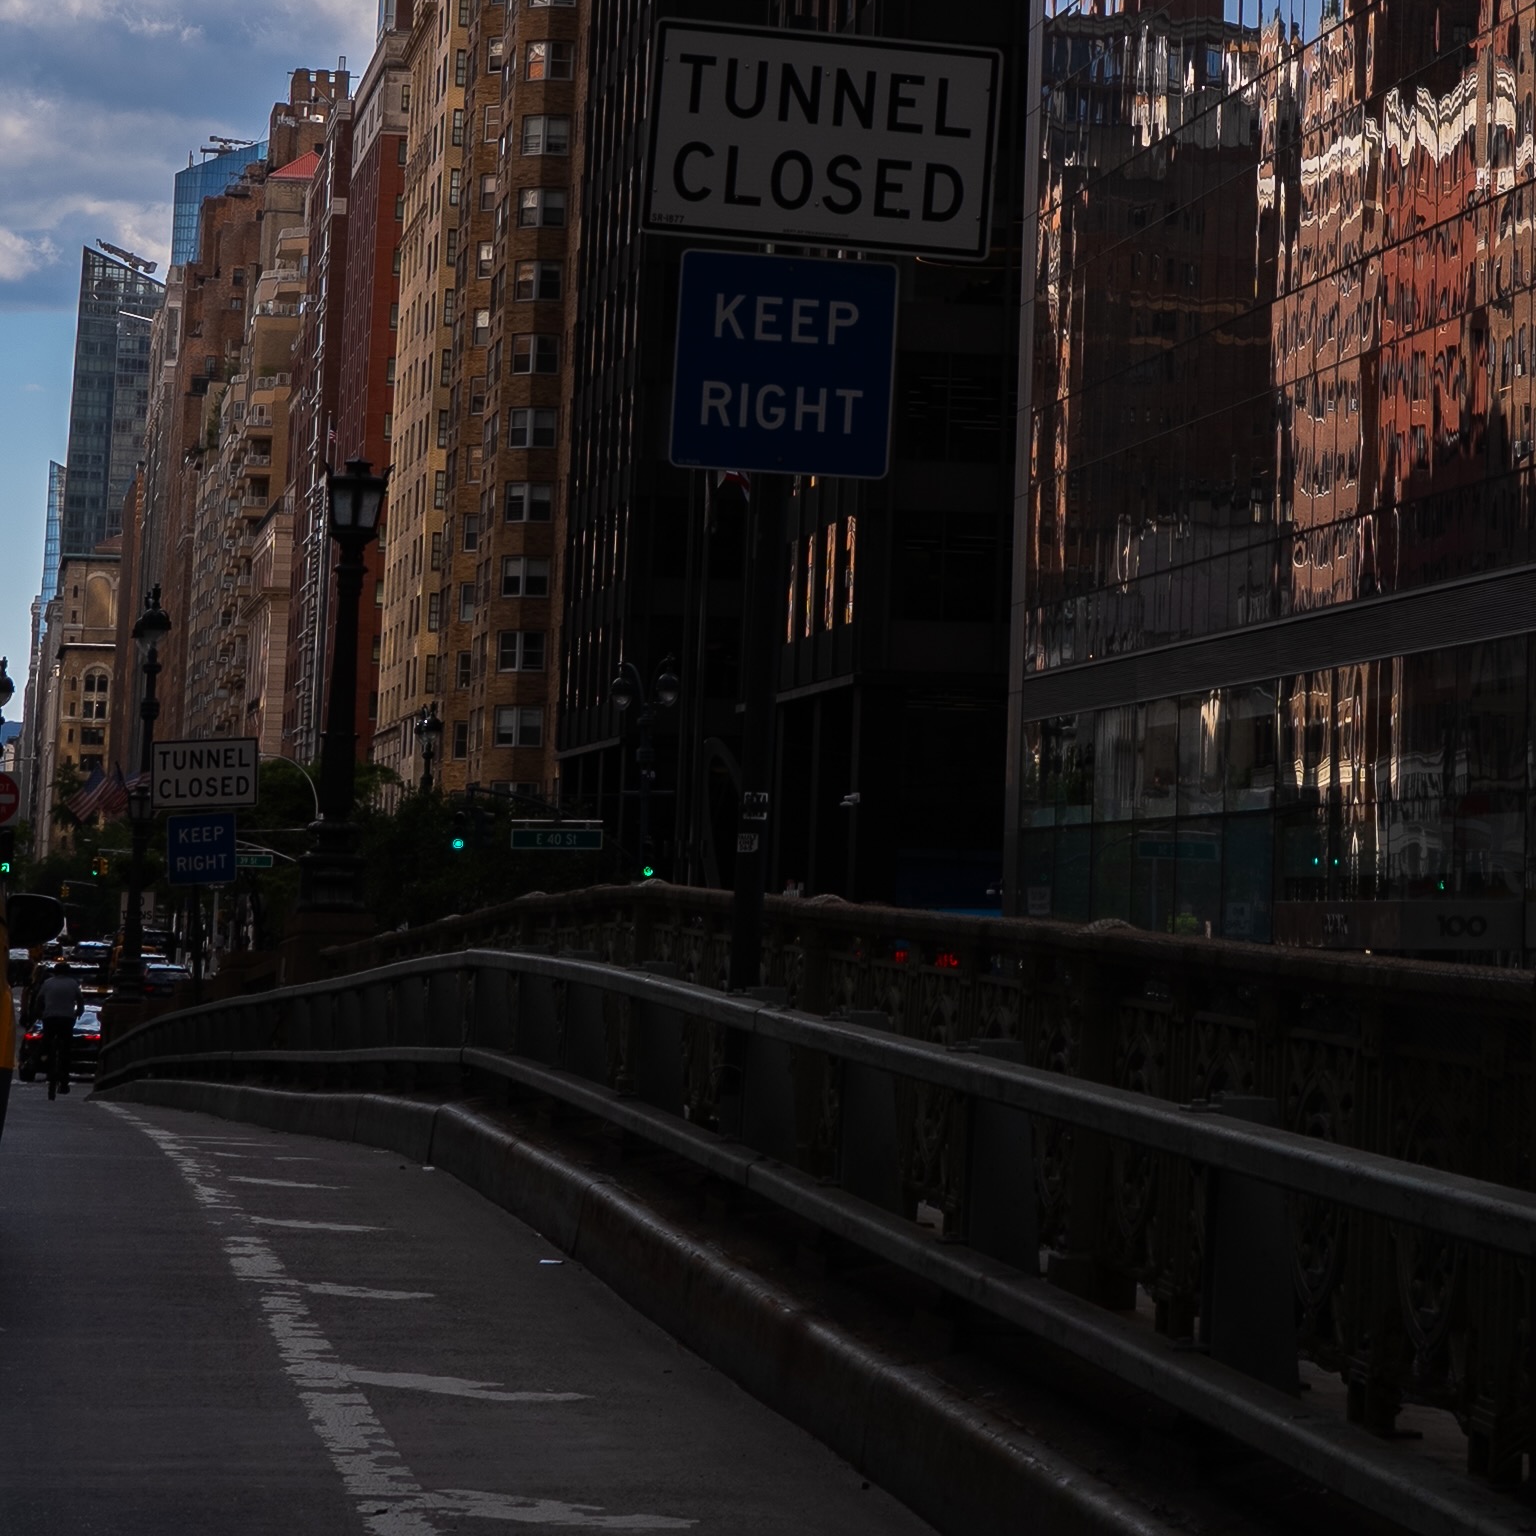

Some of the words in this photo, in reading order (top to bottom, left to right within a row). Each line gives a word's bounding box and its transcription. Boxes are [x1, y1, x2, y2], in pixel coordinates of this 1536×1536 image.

[679, 53, 972, 139] TUNNEL
[673, 141, 964, 223] CLOSED
[713, 292, 861, 346] KEEP
[699, 378, 865, 436] RIGHT
[158, 747, 251, 772] TUNNEL
[159, 775, 250, 799] CLOSED
[178, 825, 225, 845] KEEP
[536, 833, 543, 845] E
[547, 833, 562, 845] 40
[566, 833, 577, 845] St
[176, 853, 228, 873] RIGHT
[1437, 914, 1488, 937] 100
